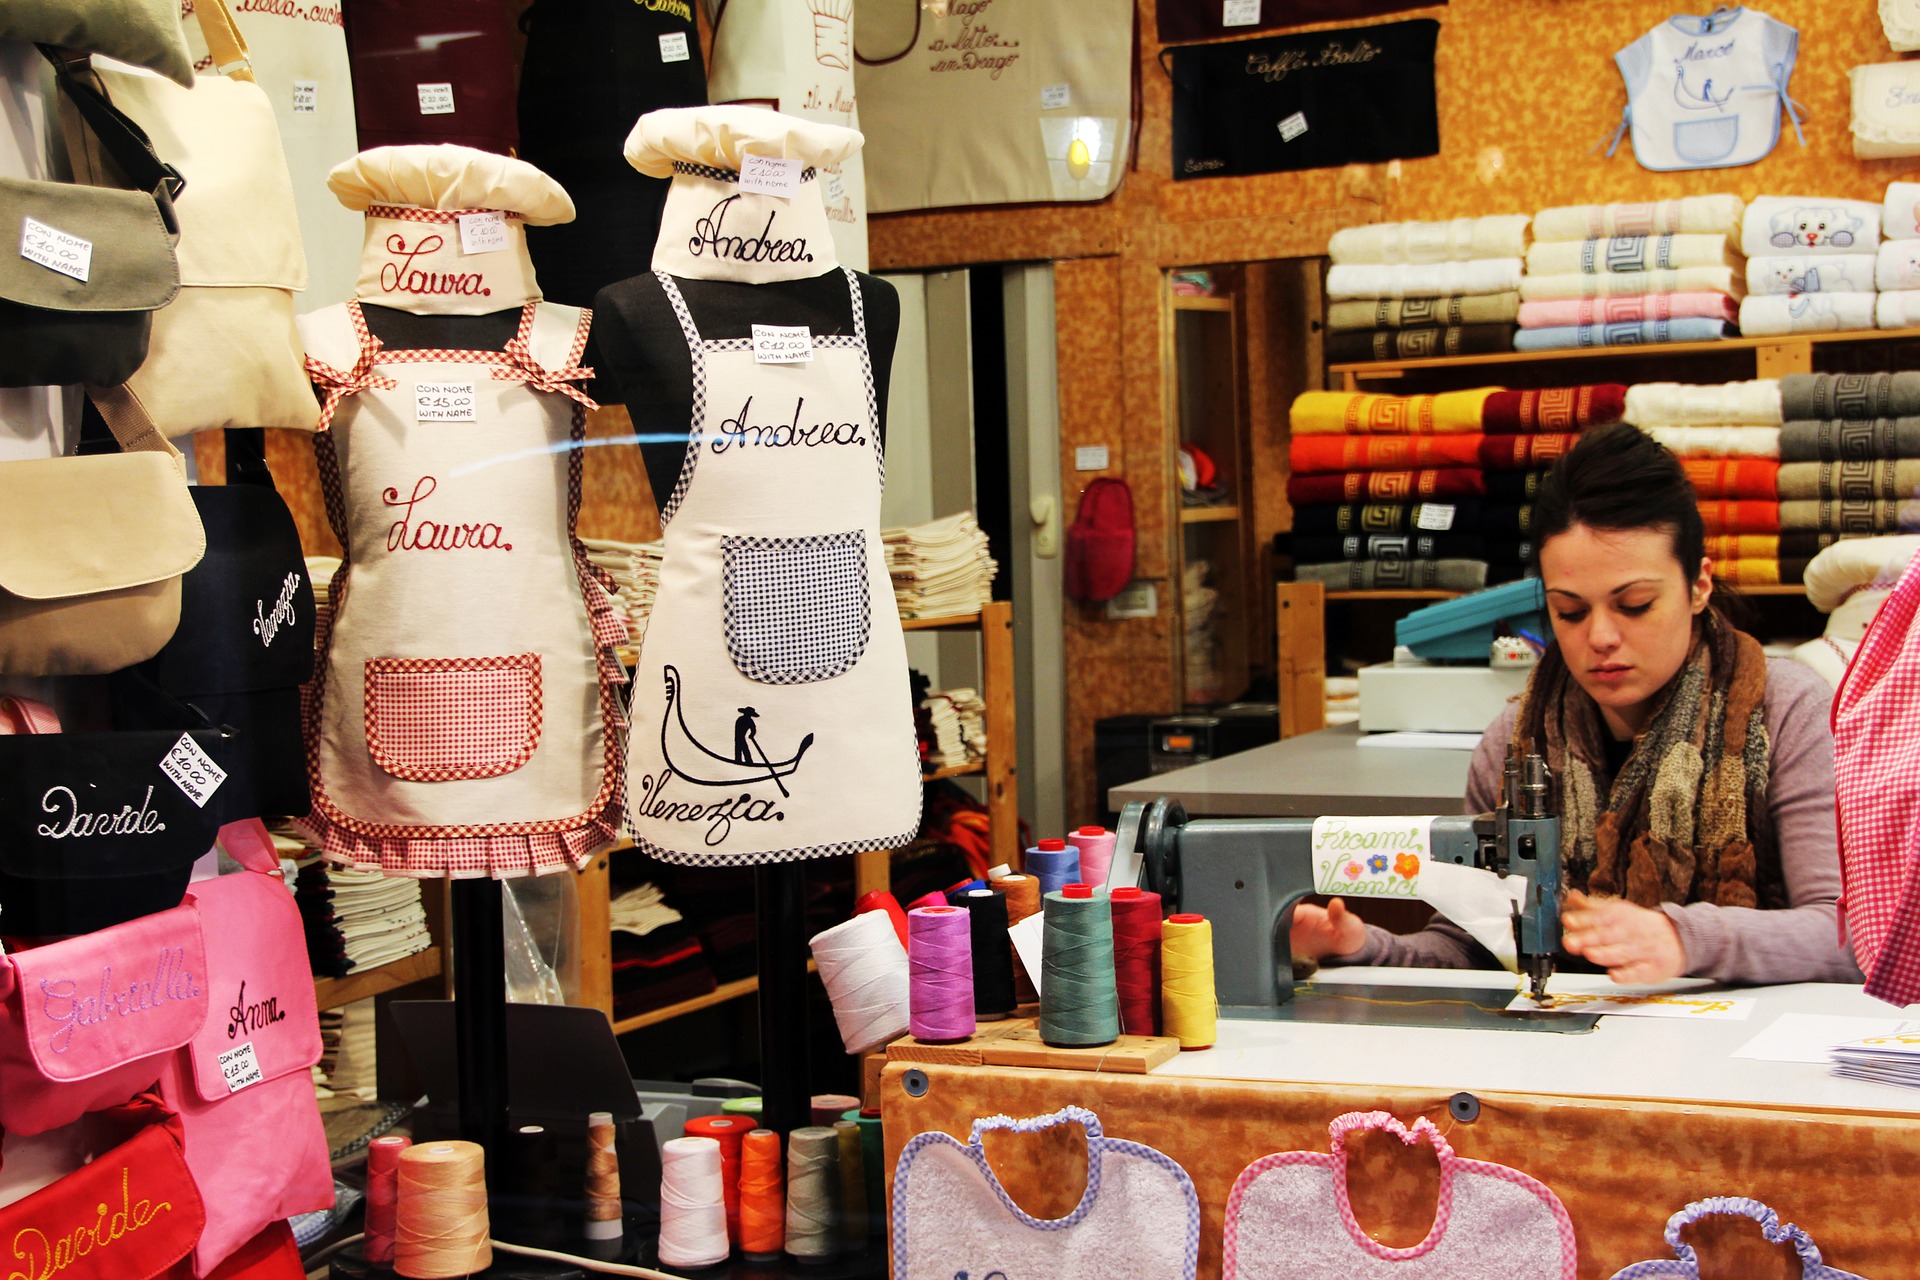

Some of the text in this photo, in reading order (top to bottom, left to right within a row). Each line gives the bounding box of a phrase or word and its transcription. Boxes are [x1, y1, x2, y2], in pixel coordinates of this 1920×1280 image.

[27, 222, 90, 251] CON NOME
[23, 247, 84, 276] WITH NAME
[753, 329, 809, 339] CON NOME
[784, 350, 811, 360] NAME
[416, 384, 473, 394] CON NOME
[419, 408, 473, 418] WITH NAME
[180, 737, 223, 783] CON NOME
[163, 760, 203, 800] WITH NAME
[219, 1045, 251, 1065] CON NOME
